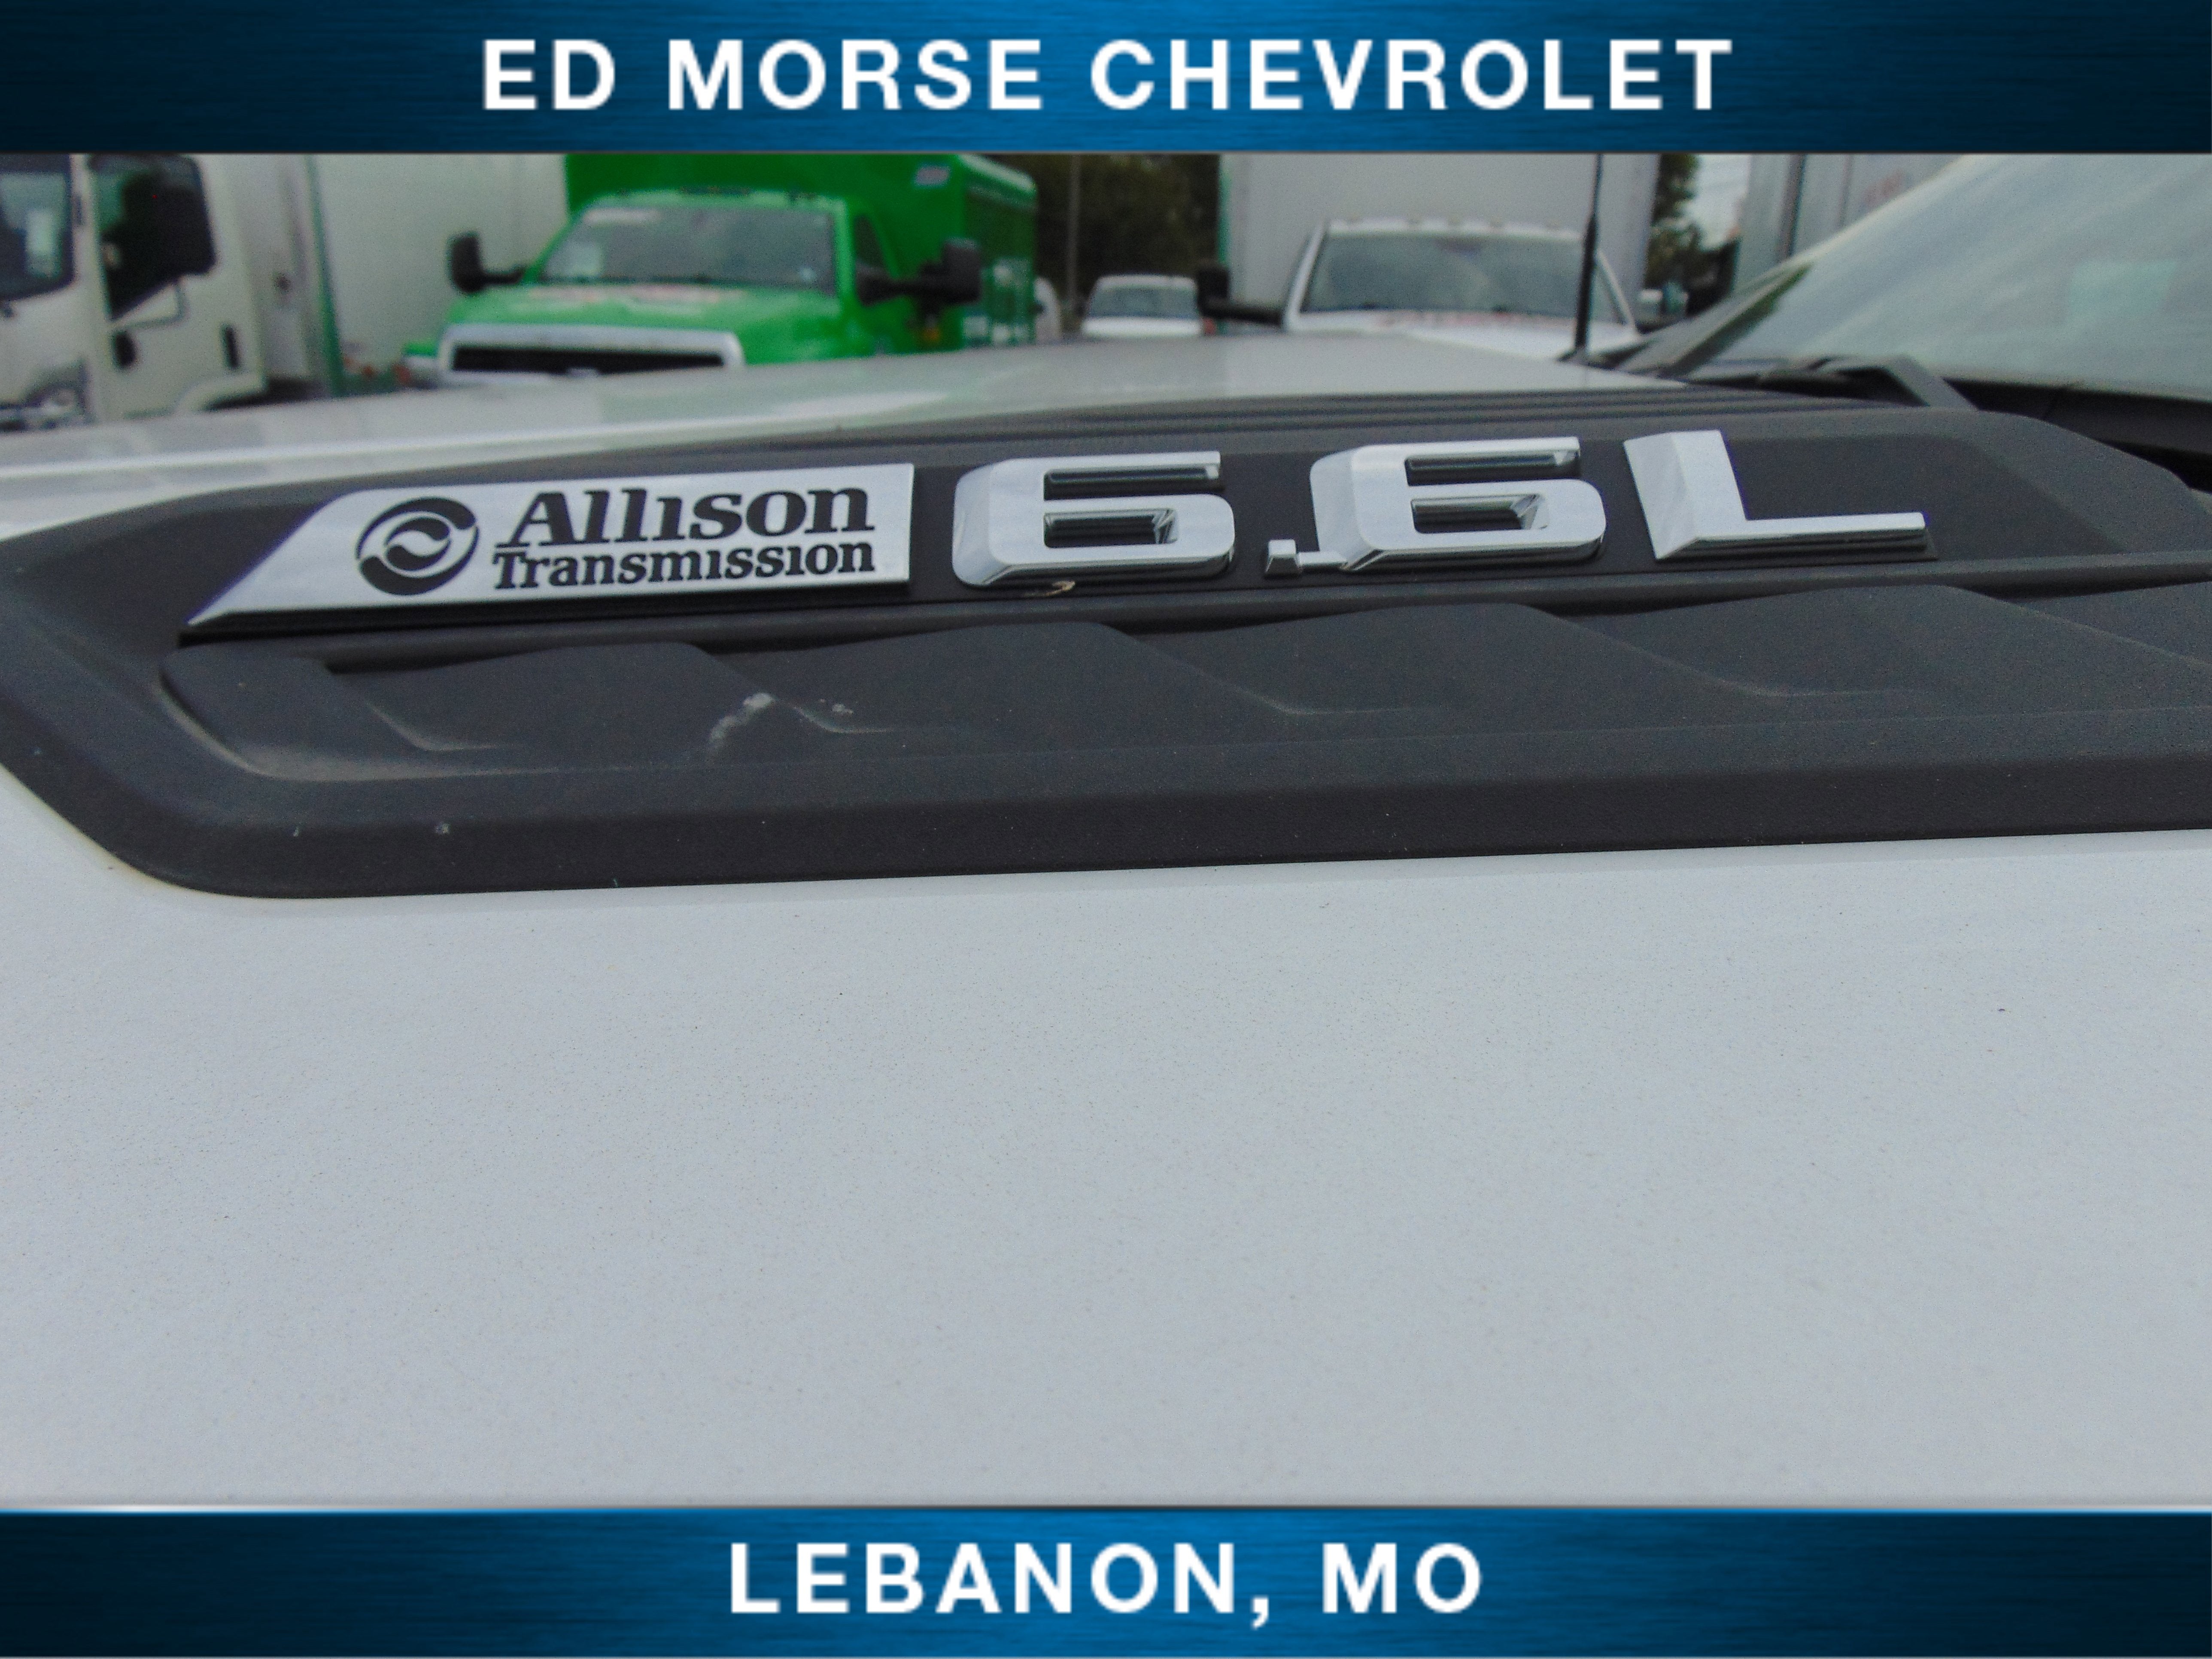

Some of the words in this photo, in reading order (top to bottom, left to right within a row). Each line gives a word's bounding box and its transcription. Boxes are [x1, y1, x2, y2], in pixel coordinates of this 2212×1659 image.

[494, 486, 875, 548] Allison
[951, 429, 1928, 587] 6.6L
[492, 541, 876, 590] Transmission
